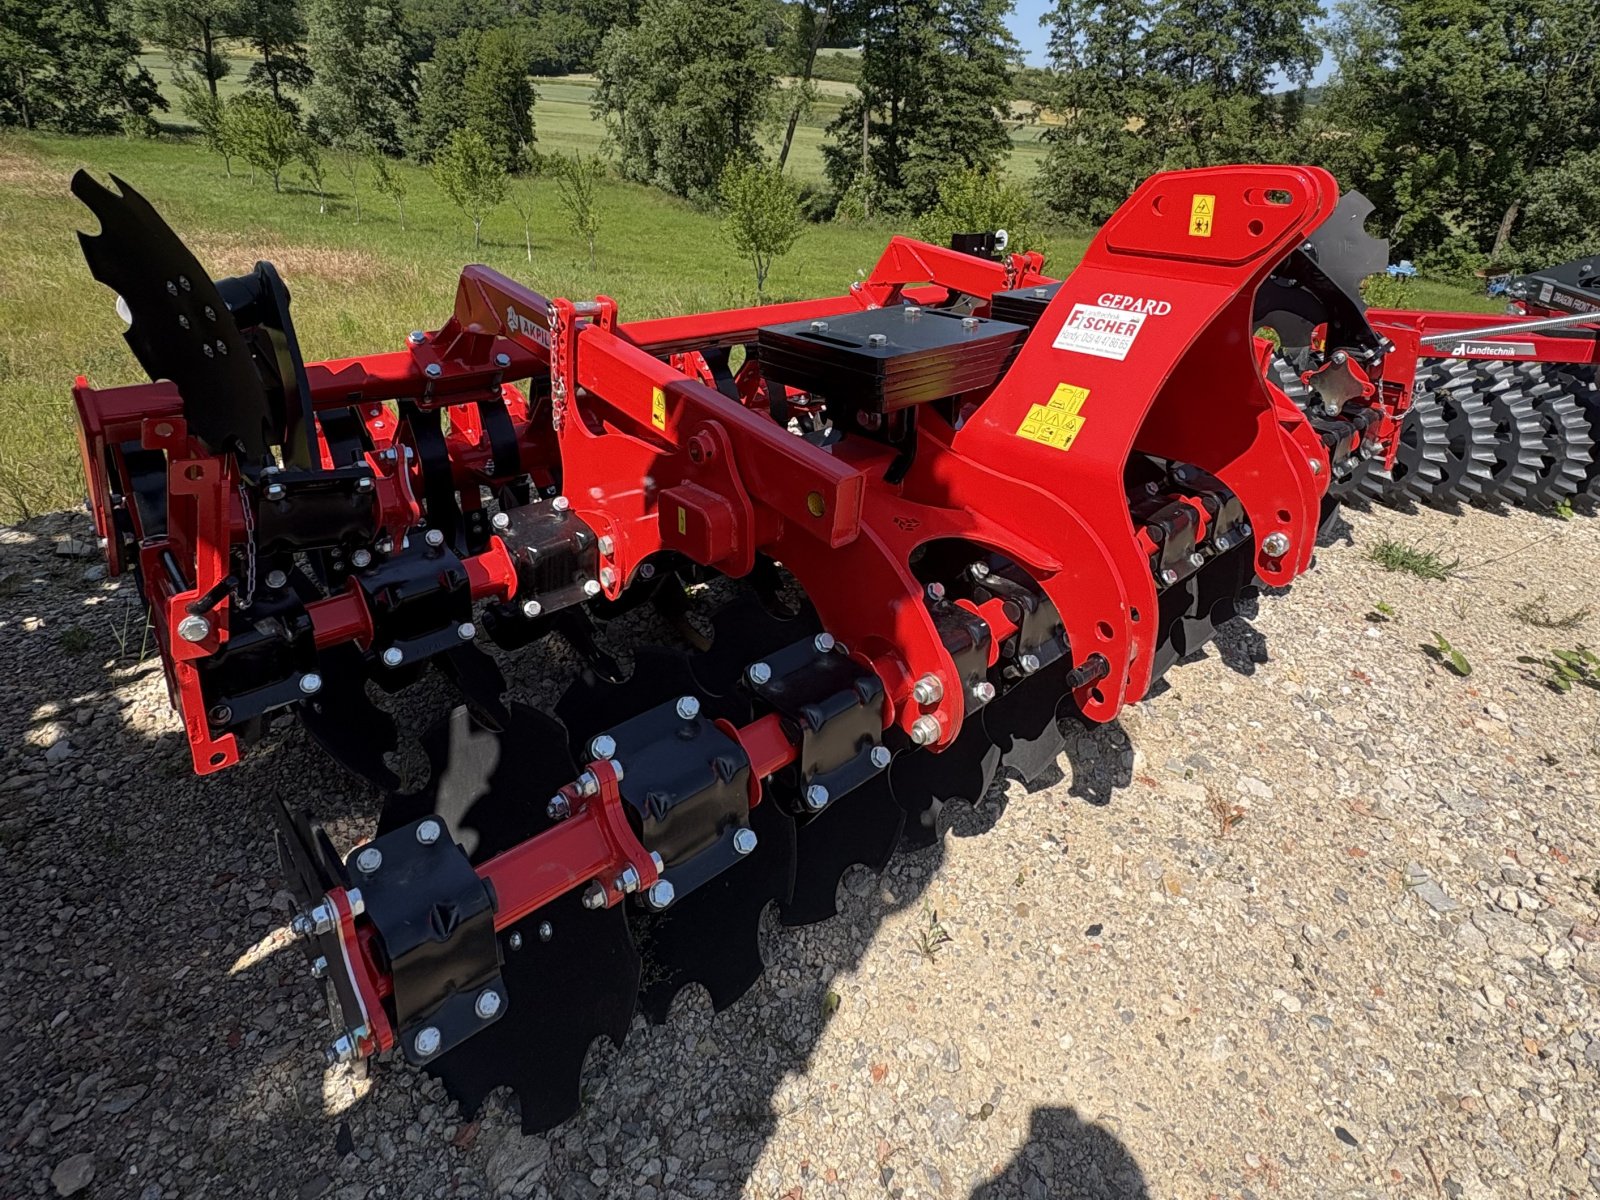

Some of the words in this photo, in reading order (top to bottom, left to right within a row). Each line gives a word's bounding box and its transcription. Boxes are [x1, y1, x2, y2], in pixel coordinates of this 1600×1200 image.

[1097, 293, 1171, 316] GEPARD
[523, 320, 549, 346] AKPIL
[1068, 310, 1138, 337] FISCHER
[1466, 345, 1515, 356] Landtechnik
